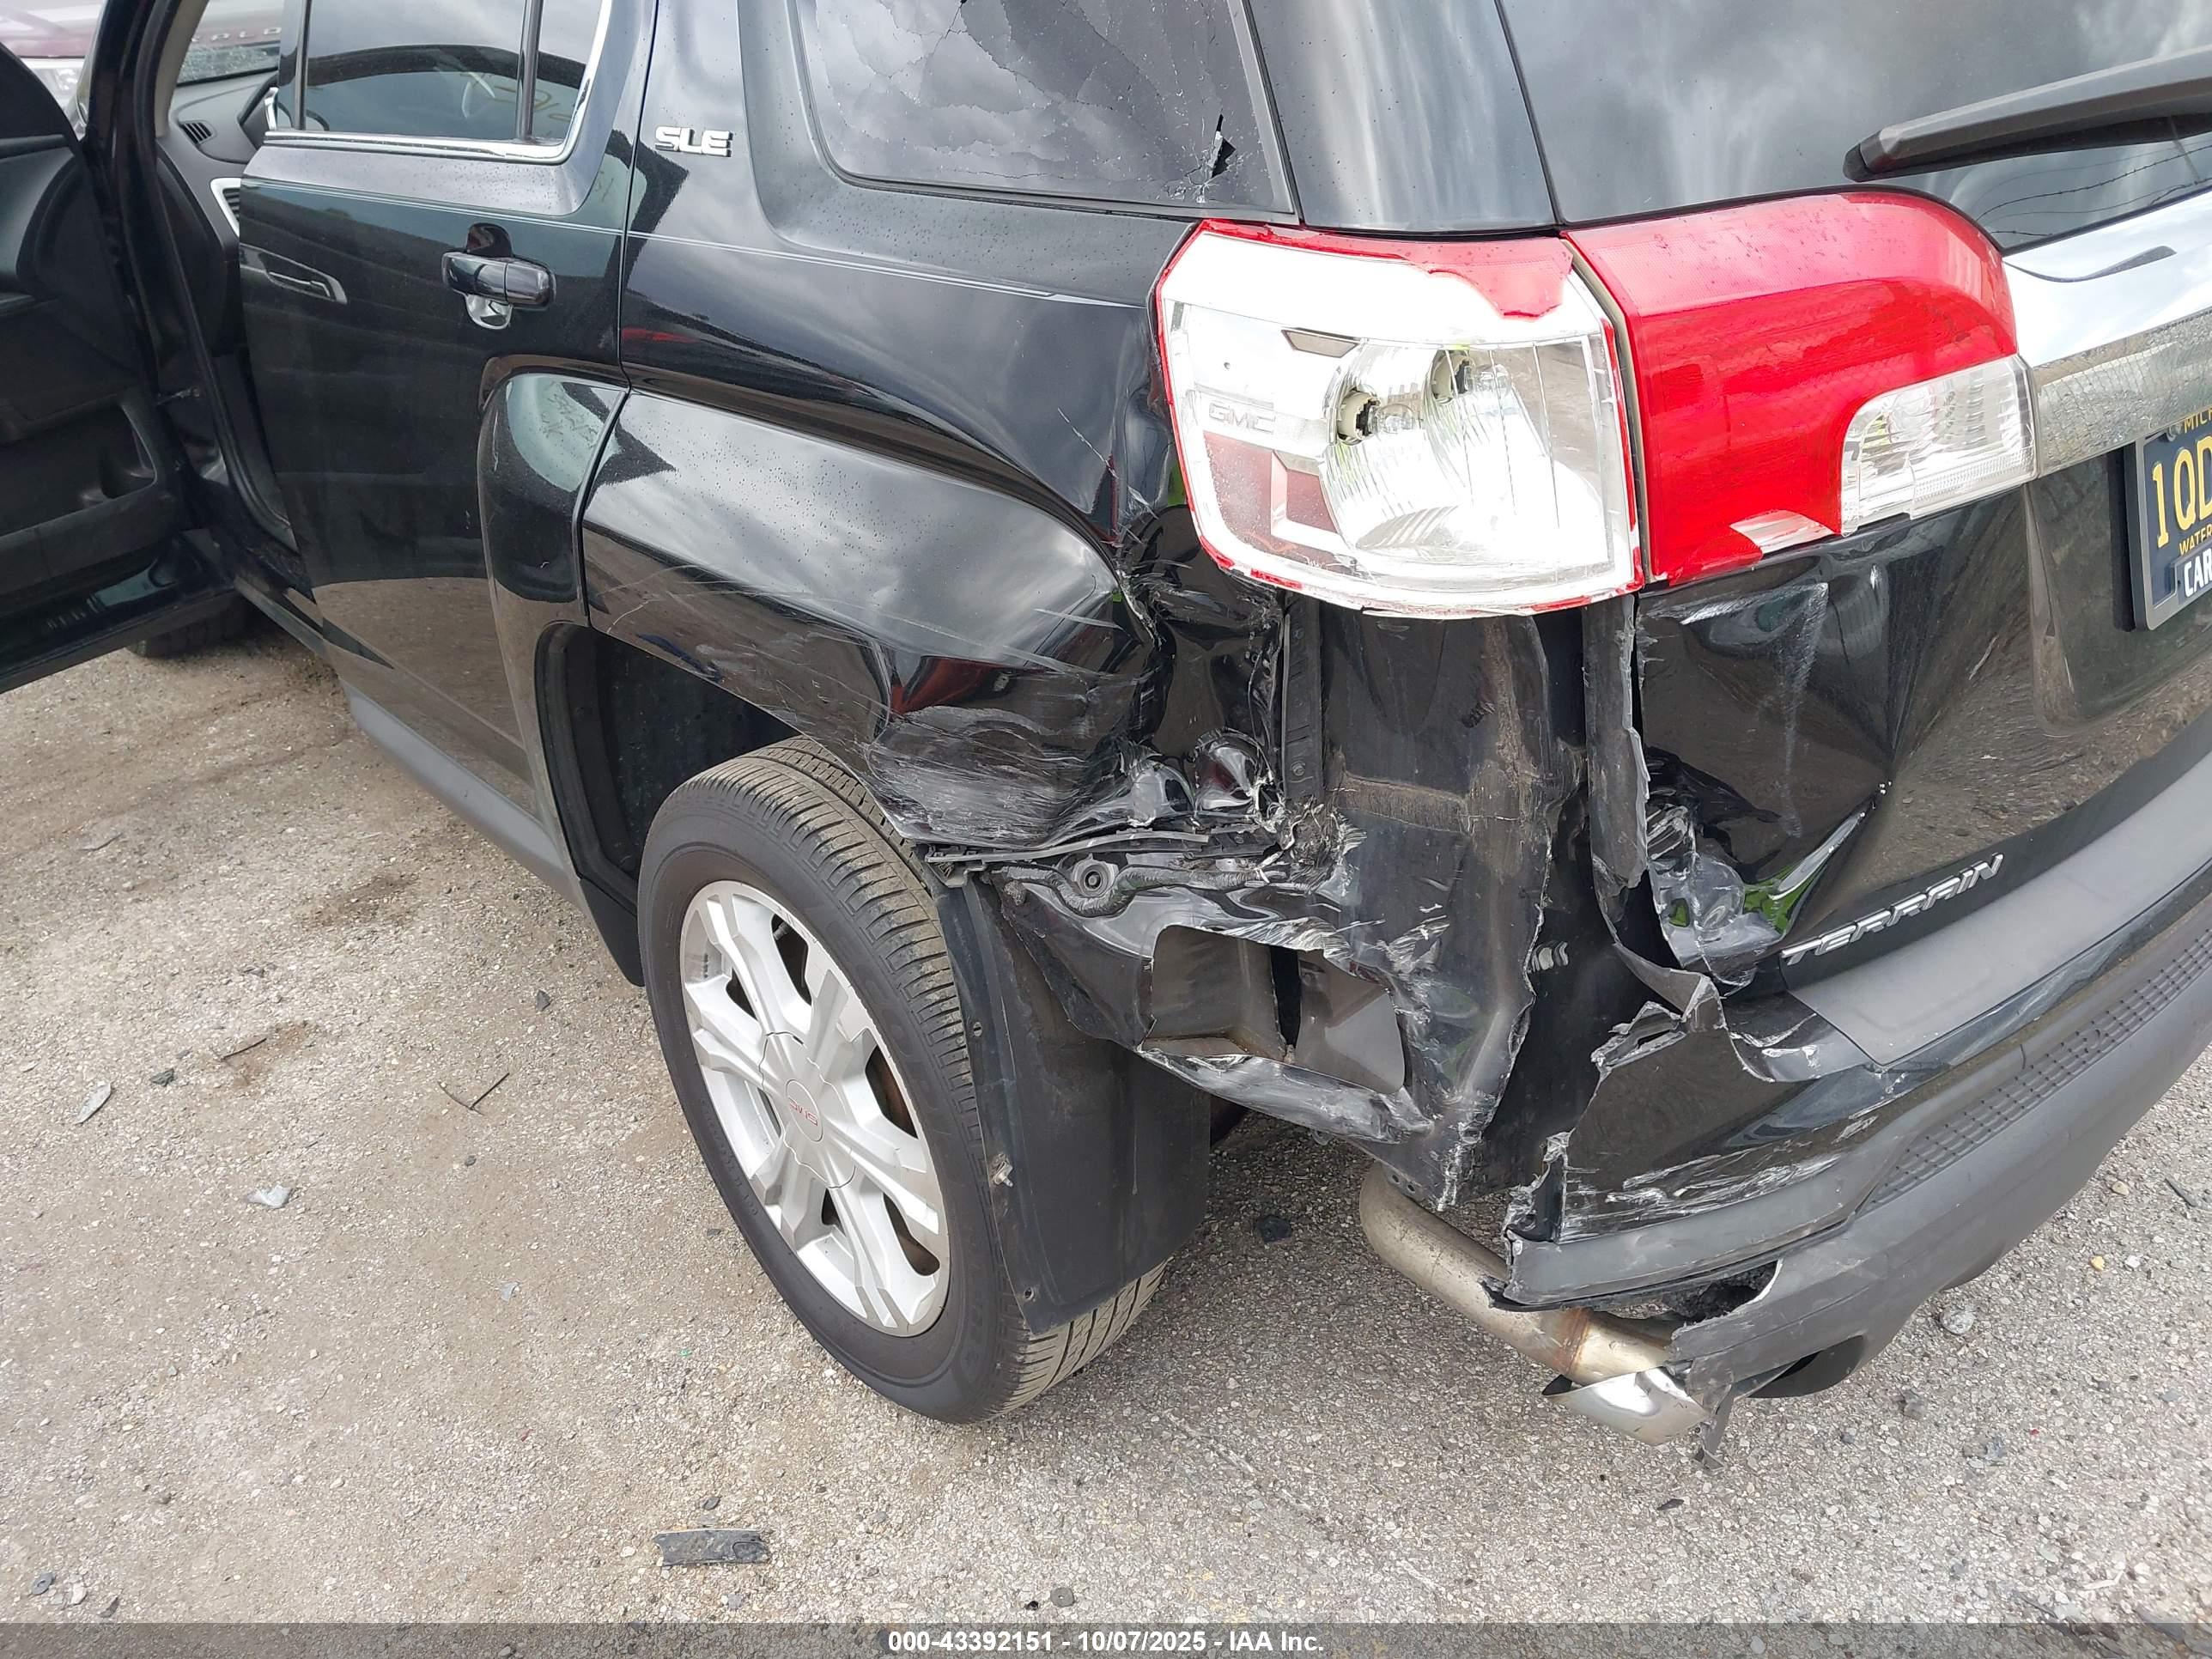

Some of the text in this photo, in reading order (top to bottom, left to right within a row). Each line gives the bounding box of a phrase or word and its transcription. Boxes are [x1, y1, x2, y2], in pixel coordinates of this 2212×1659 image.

[655, 126, 733, 157] SLE
[1209, 400, 1276, 434] GMC
[1781, 853, 2004, 965] TERRAIN
